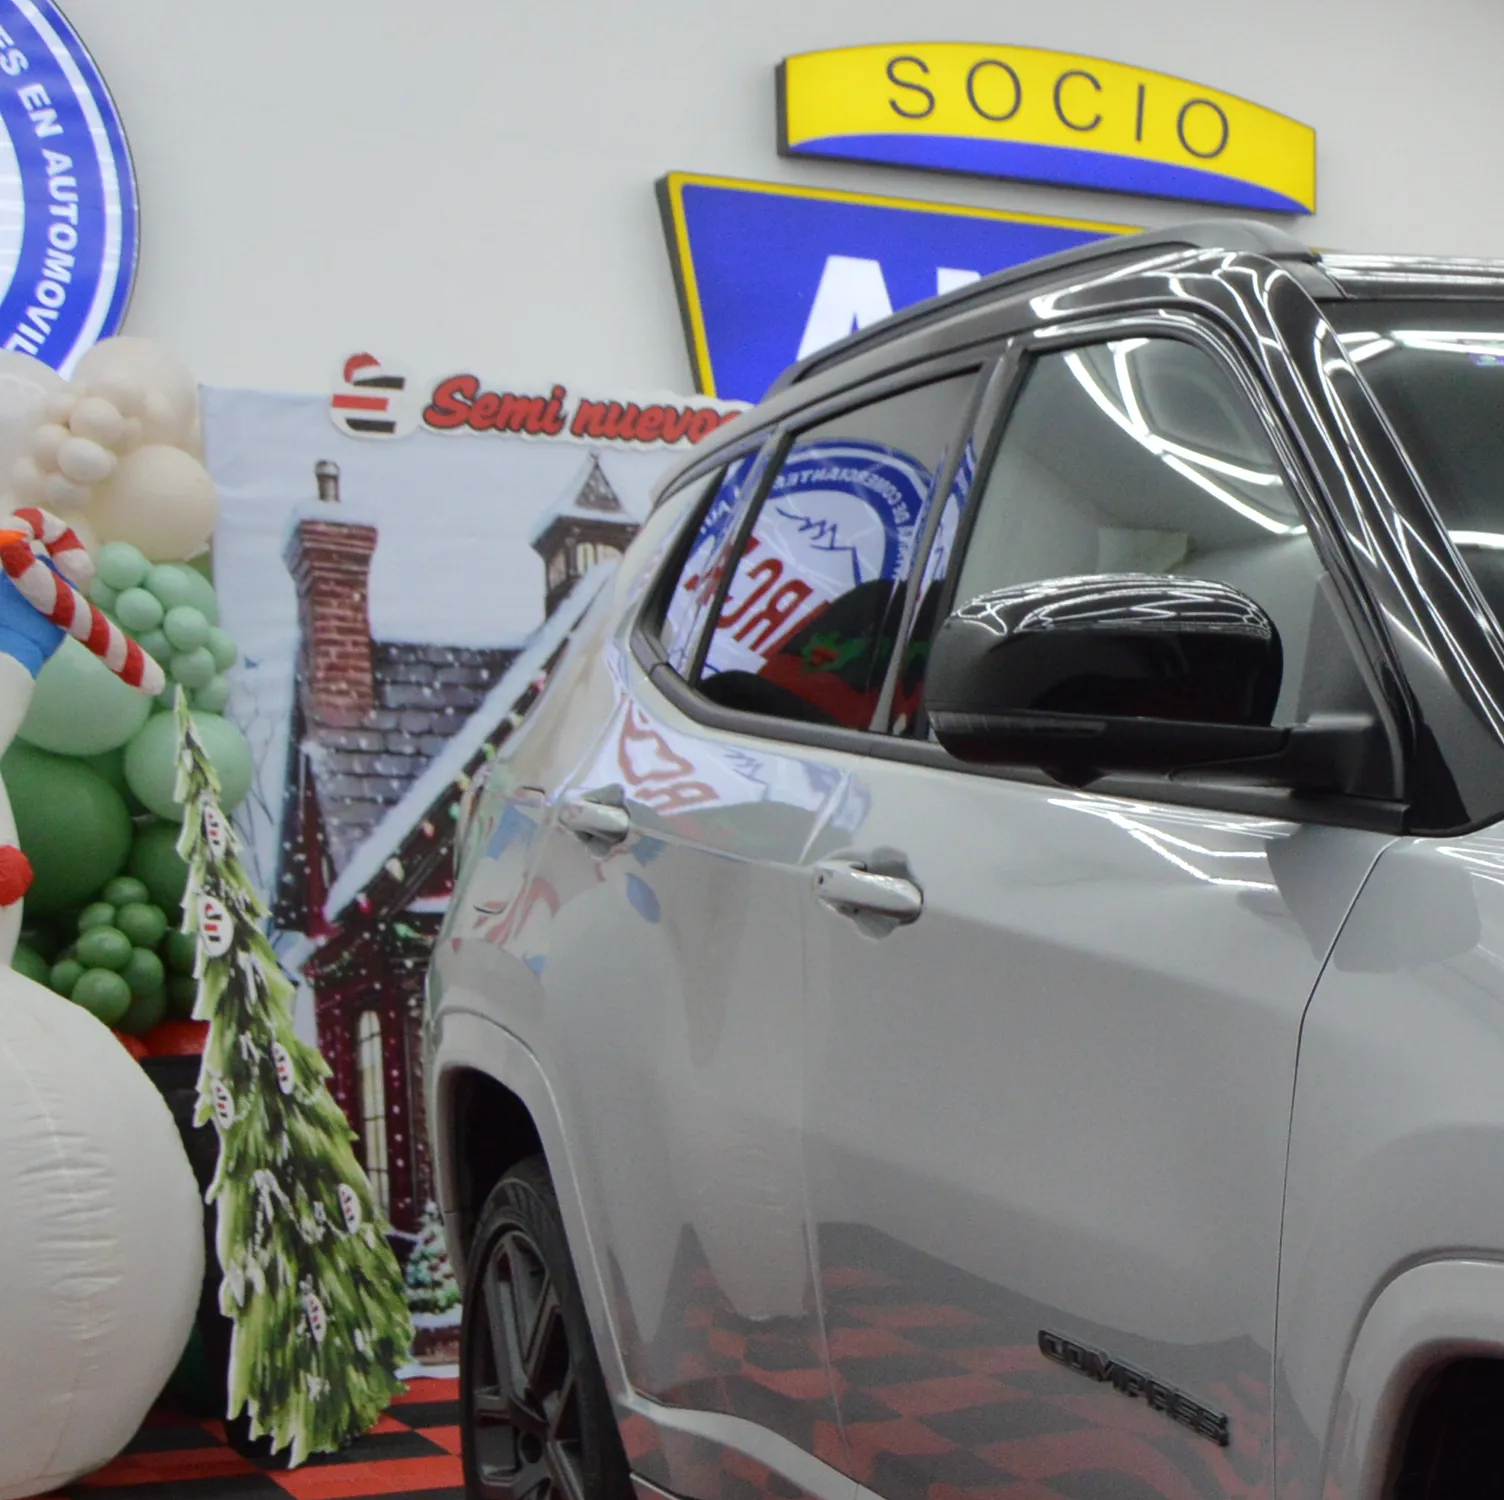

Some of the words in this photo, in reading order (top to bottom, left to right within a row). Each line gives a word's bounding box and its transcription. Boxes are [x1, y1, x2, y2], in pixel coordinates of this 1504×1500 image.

[17, 83, 64, 138] EN
[886, 55, 1229, 159] SOCIO
[423, 374, 566, 435] Semi
[570, 396, 742, 444] nuevo
